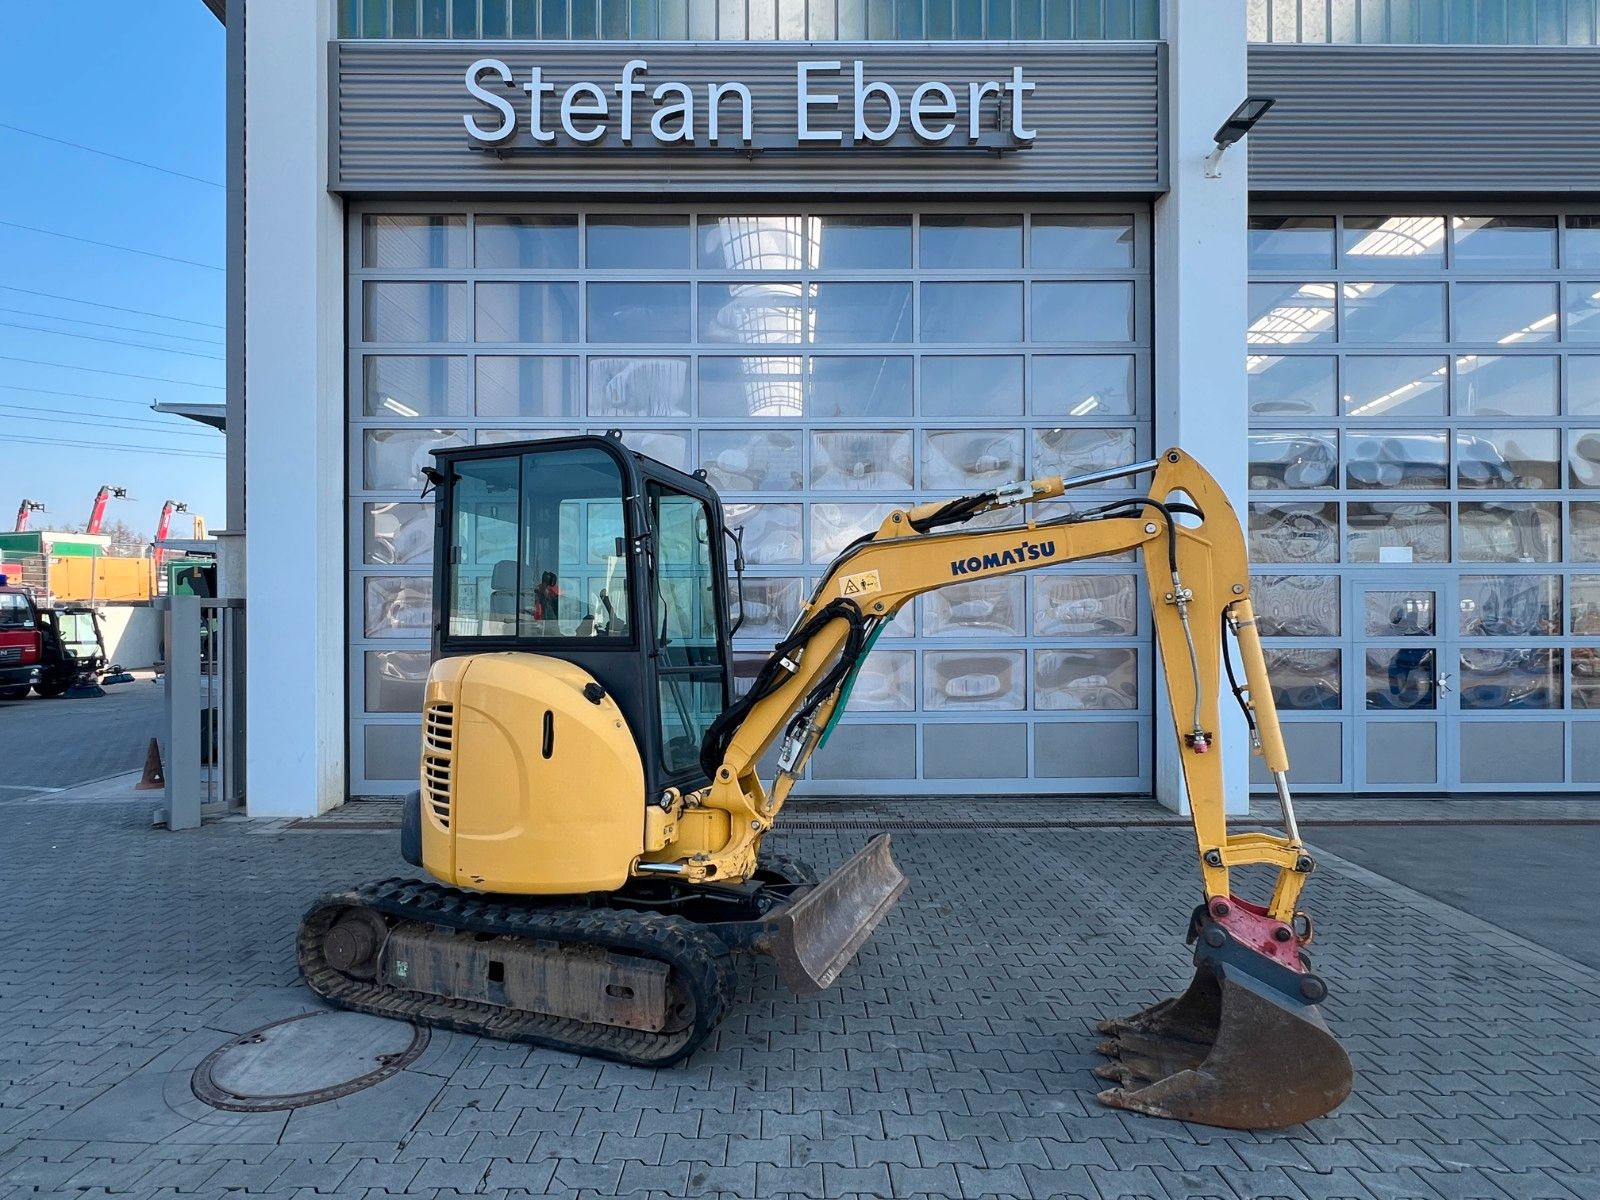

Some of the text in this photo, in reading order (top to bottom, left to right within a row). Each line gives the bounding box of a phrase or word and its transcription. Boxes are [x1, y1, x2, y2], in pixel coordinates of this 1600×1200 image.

[463, 58, 1037, 142] Stefan Ebert
[950, 541, 1056, 576] KOMATSU
